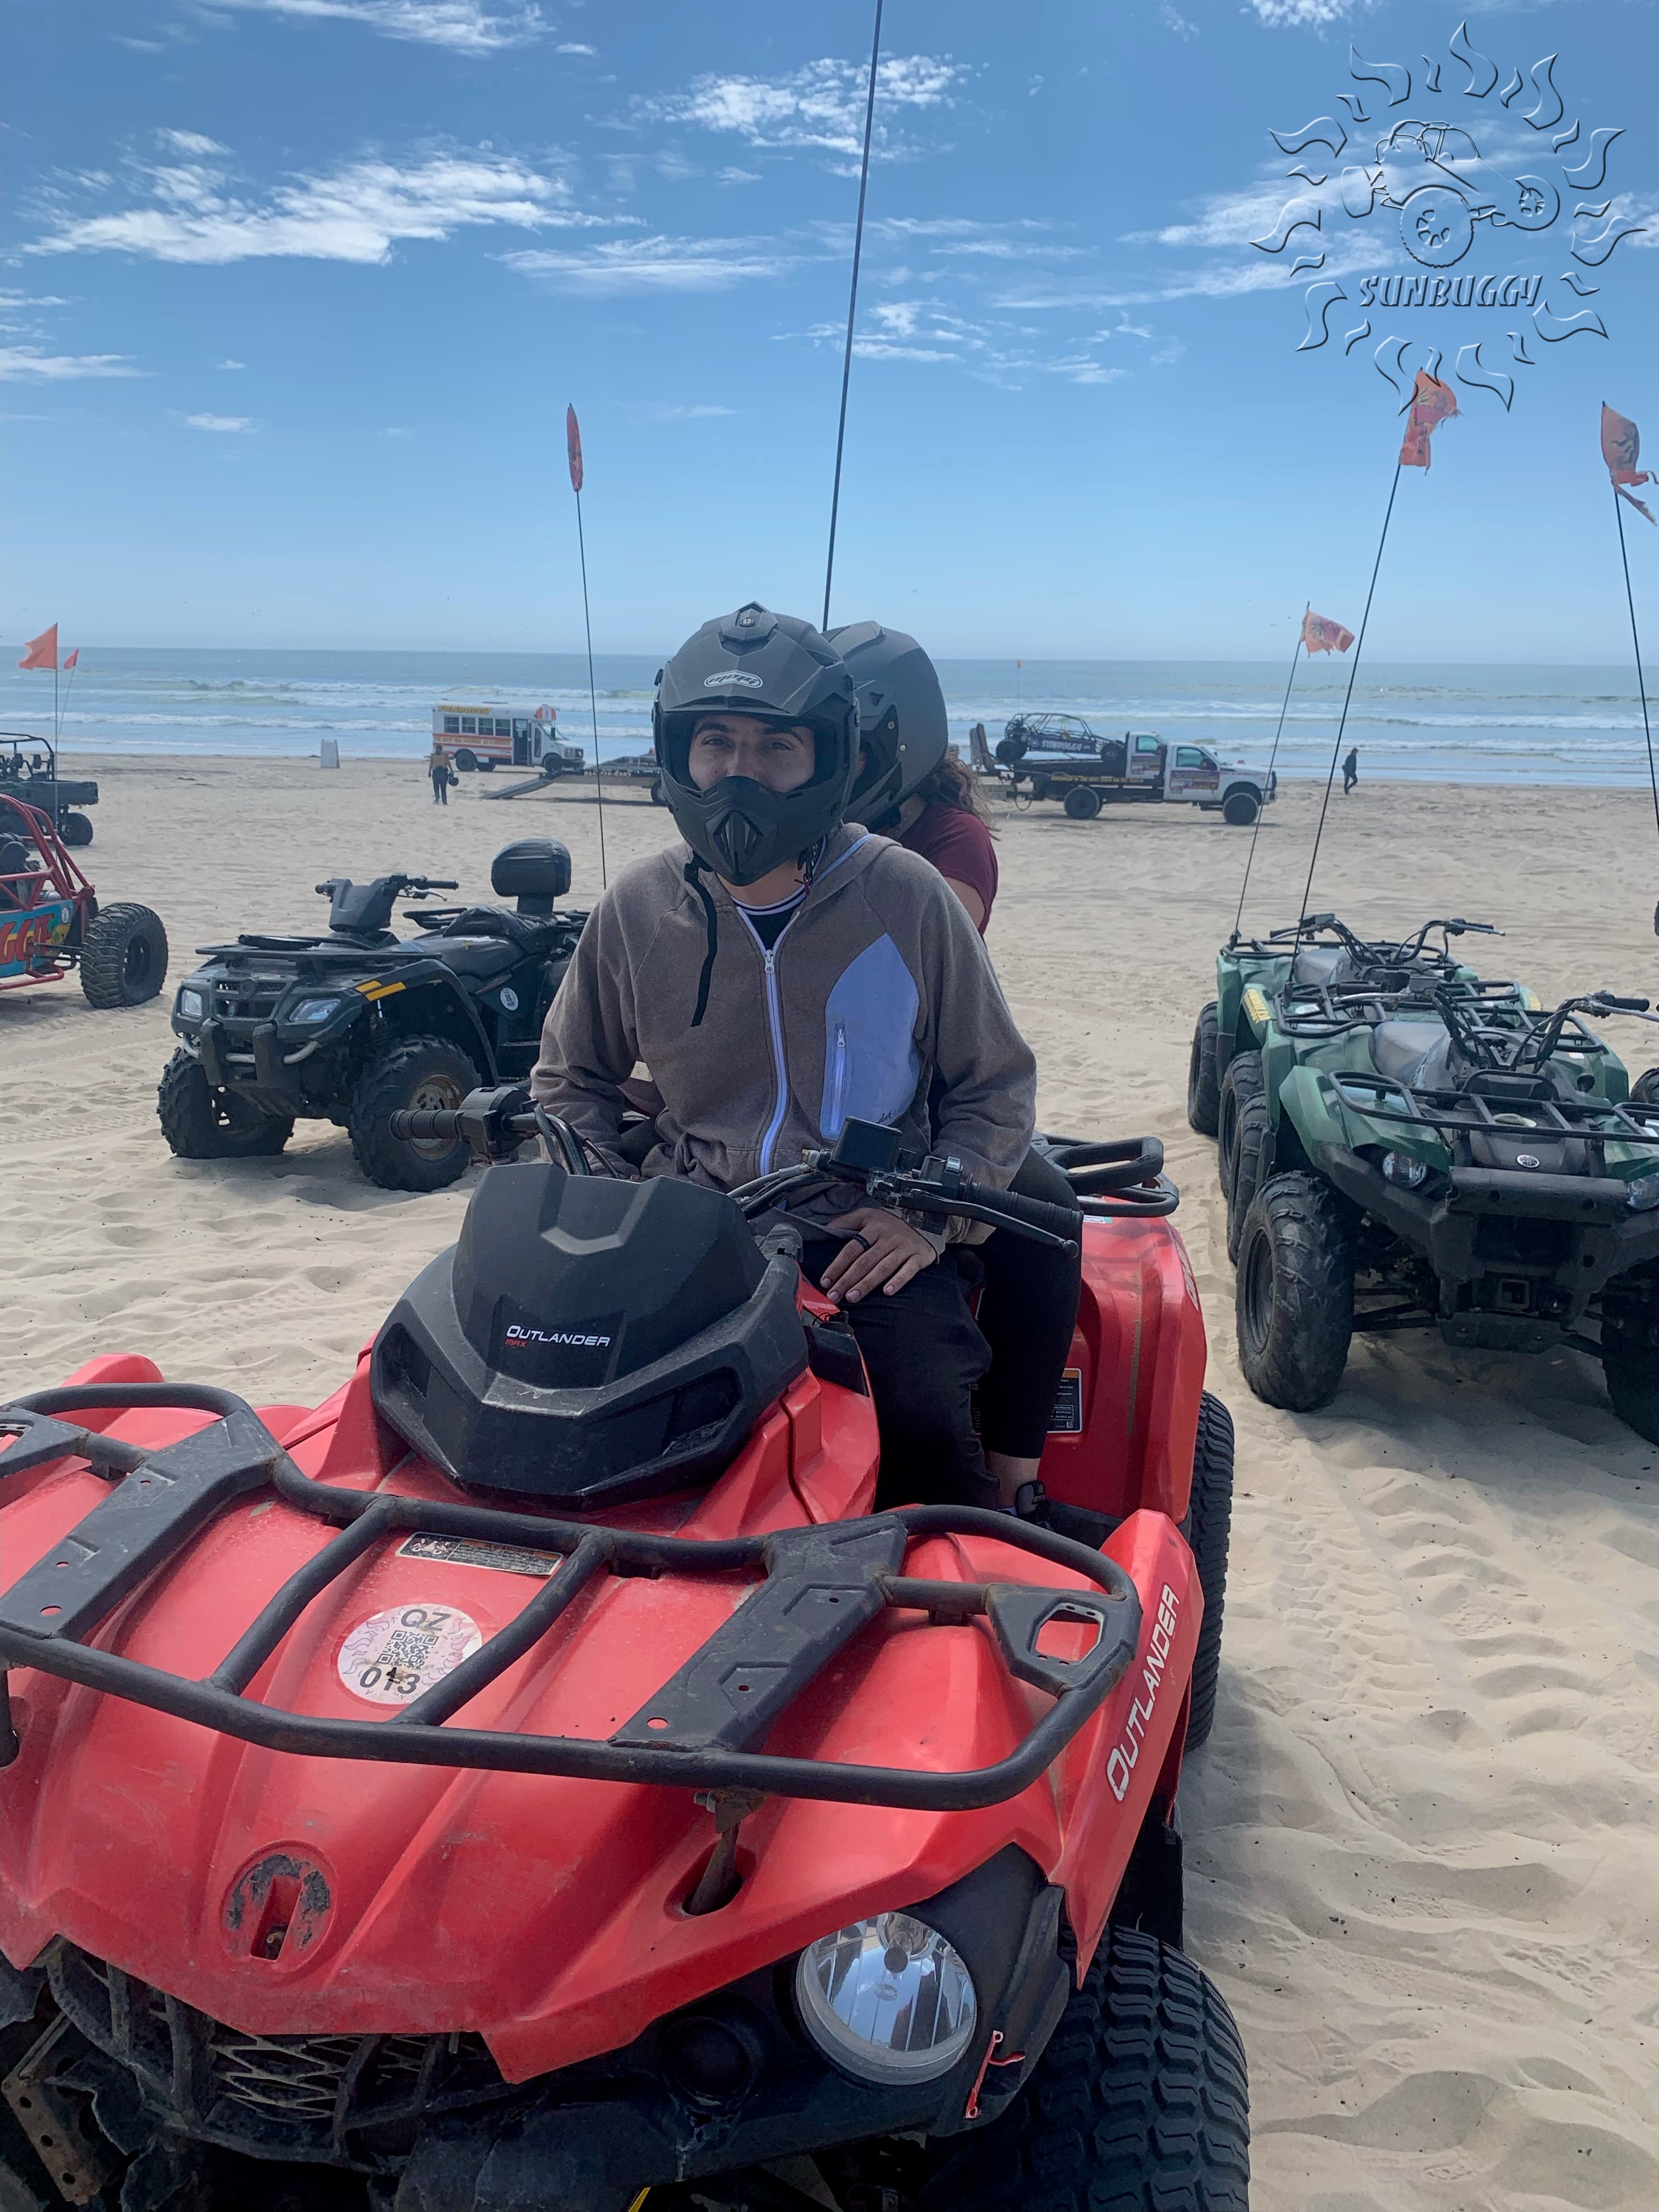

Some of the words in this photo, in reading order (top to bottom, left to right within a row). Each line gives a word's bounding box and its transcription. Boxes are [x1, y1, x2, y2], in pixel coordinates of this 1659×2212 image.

[506, 1324, 611, 1347] OUTLANDER
[400, 1609, 452, 1632] QZ
[359, 1667, 421, 1695] 013
[1107, 1584, 1180, 1802] OUTLANDER
